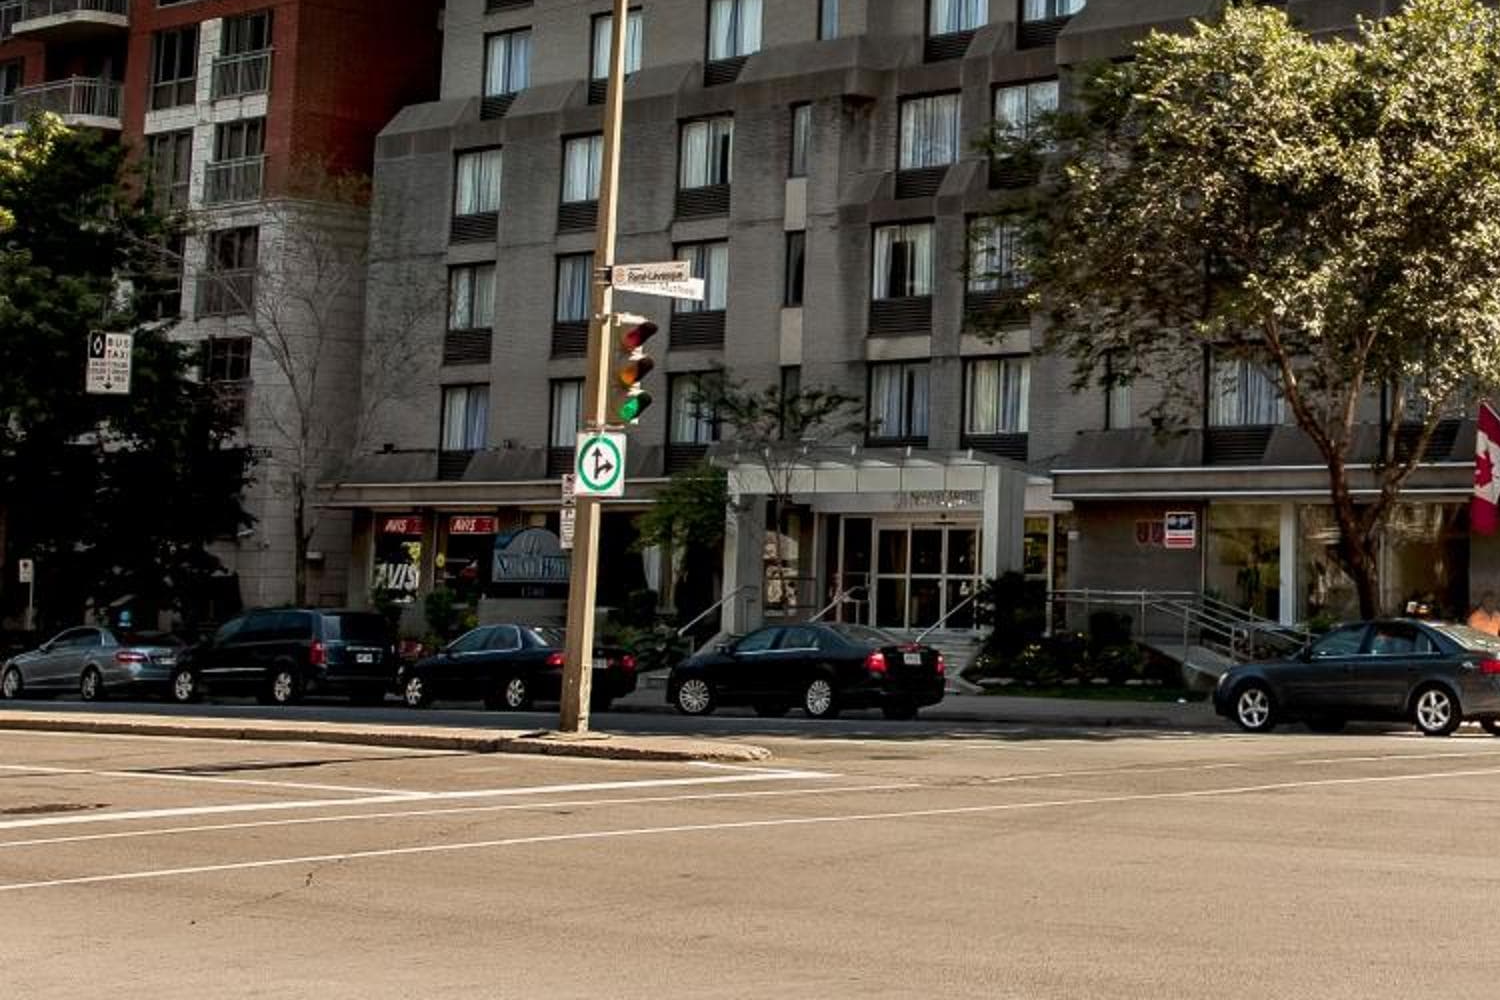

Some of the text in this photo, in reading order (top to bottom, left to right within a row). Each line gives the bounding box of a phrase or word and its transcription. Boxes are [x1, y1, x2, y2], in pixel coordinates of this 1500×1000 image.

[108, 337, 129, 348] BUS
[108, 350, 129, 360] TAXI
[374, 563, 417, 591] AVIS
